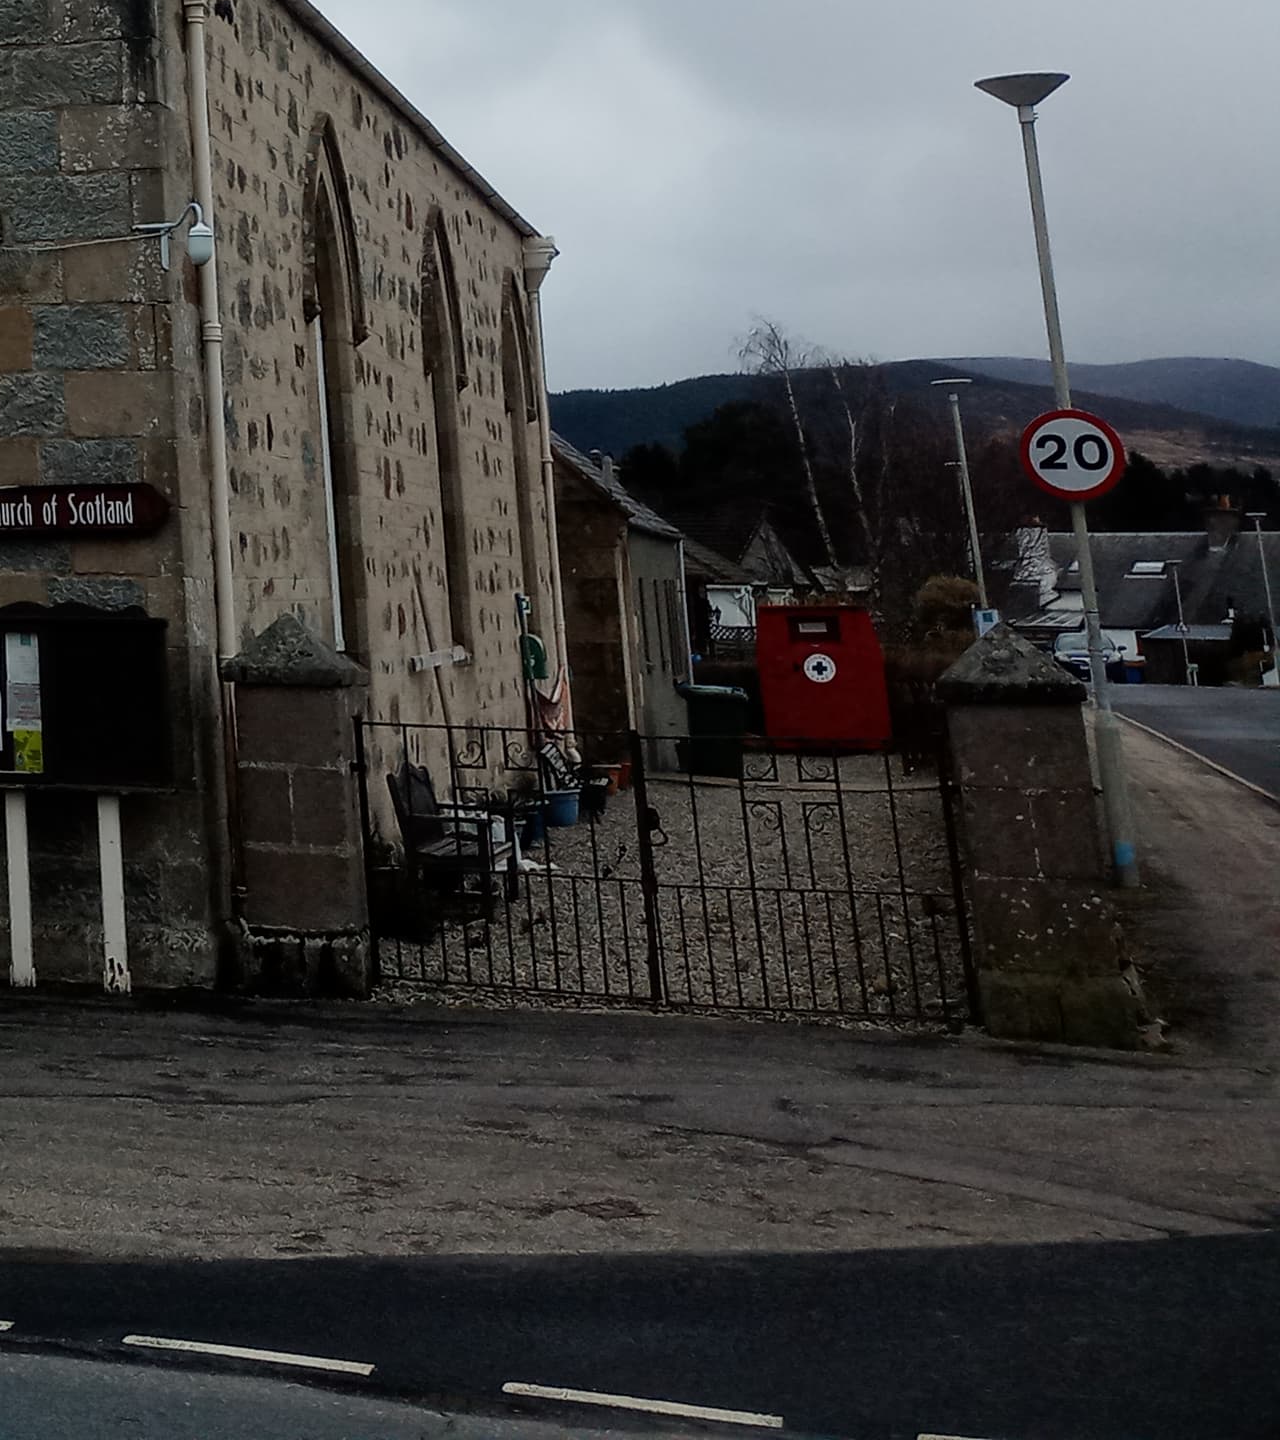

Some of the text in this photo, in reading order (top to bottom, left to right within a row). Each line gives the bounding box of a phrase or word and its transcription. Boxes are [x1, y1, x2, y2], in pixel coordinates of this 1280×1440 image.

[1036, 433, 1109, 471] 20
[42, 493, 58, 526] of
[67, 492, 134, 525] Scotland
